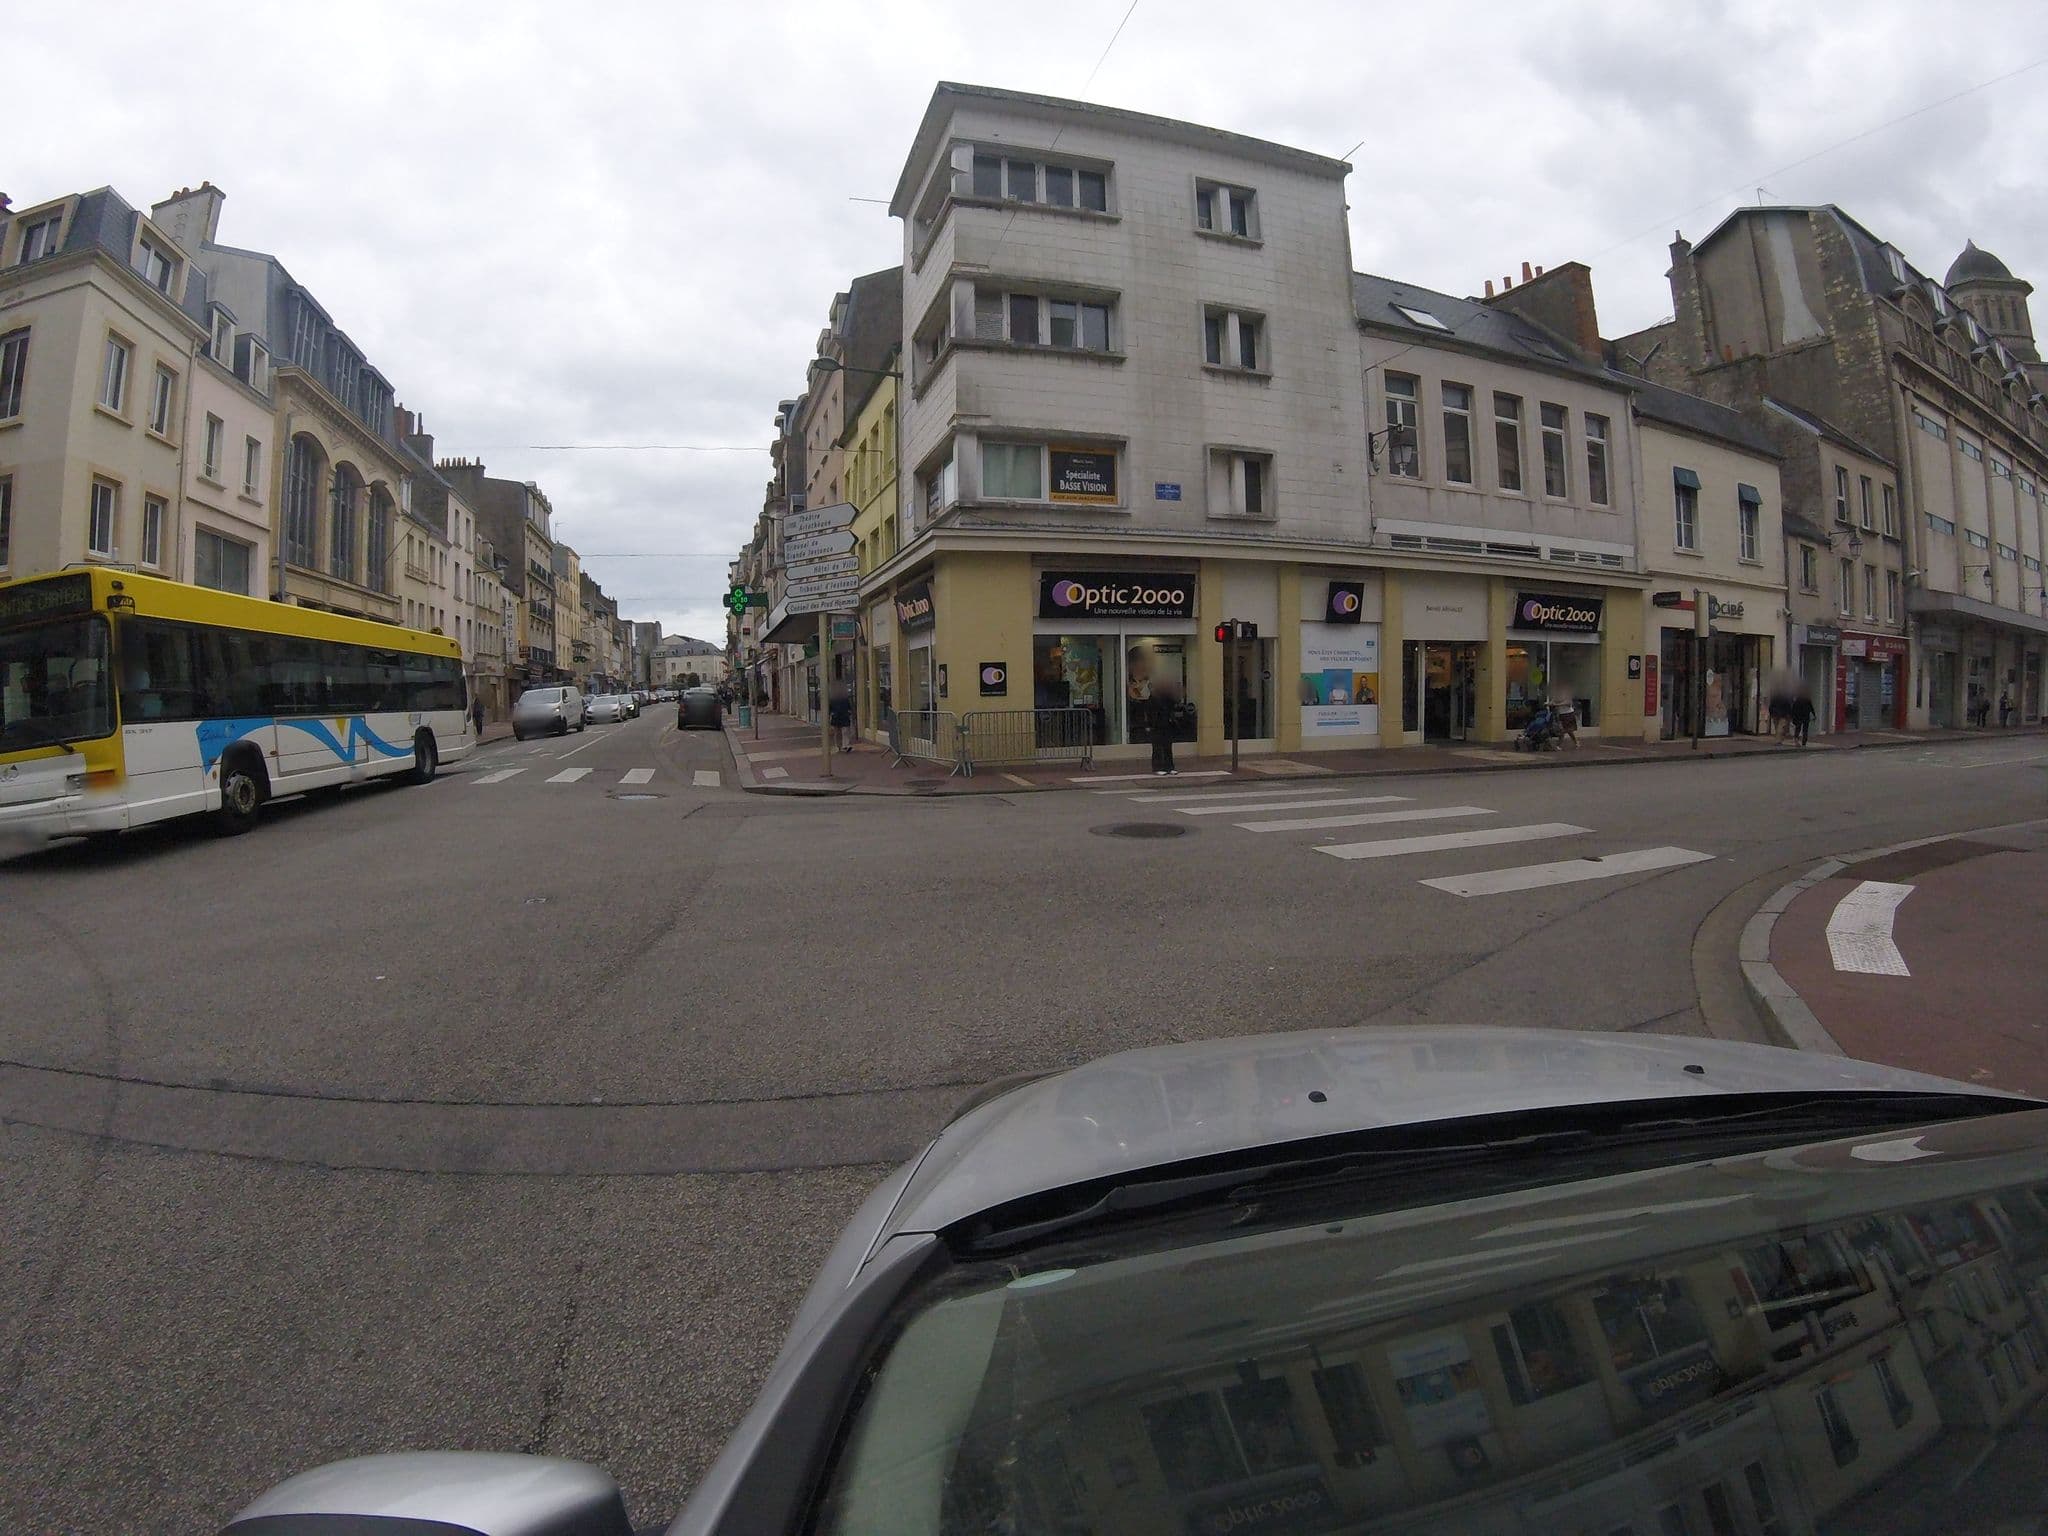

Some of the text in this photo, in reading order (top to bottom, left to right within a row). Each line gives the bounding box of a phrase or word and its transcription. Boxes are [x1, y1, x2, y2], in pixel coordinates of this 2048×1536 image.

[813, 565, 829, 574] Hôtel
[842, 559, 857, 569] Ville
[1066, 582, 1185, 610] Optic 2000
[1108, 607, 1136, 615] nouvelle
[1531, 602, 1596, 624] Optic 2000
